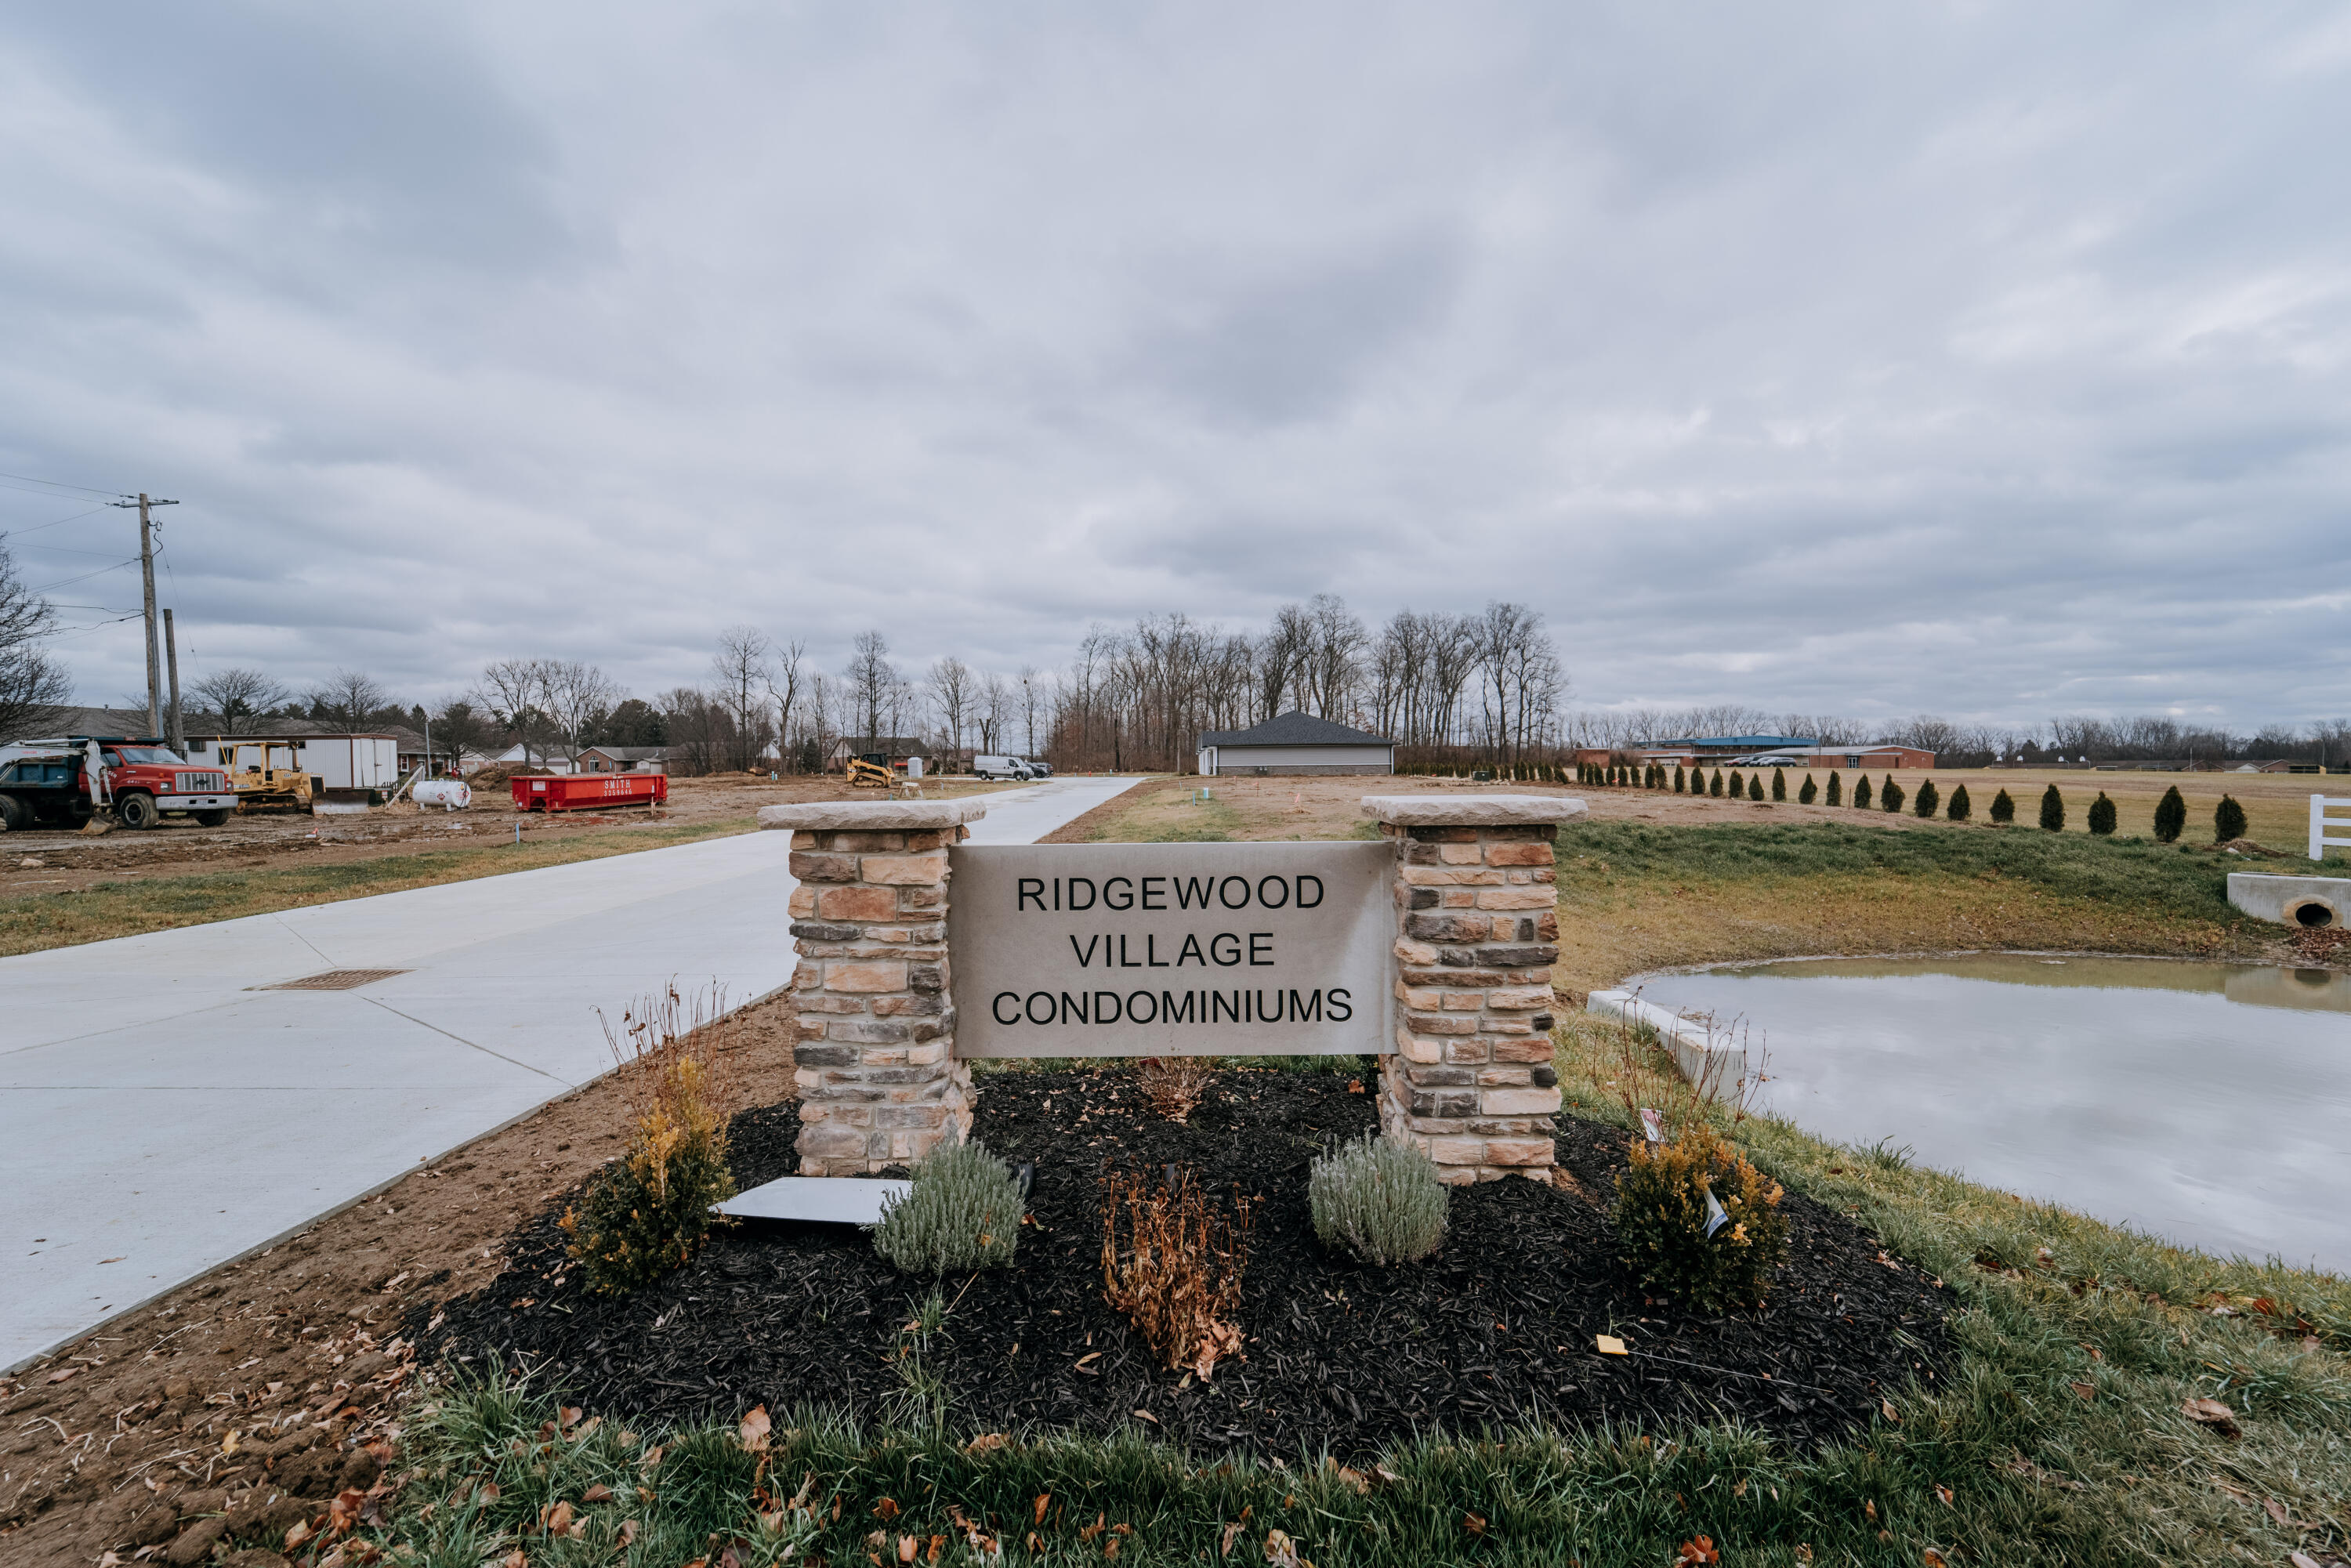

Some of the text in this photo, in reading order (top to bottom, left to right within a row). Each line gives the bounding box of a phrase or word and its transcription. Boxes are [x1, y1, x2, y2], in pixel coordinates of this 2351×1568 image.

[603, 788, 632, 797] 3259646
[604, 779, 630, 789] SMITH
[1018, 875, 1324, 911] RIDGEWOOD
[1069, 932, 1275, 968] VILLAGE
[992, 988, 1353, 1026] CONDOMINIUMS
